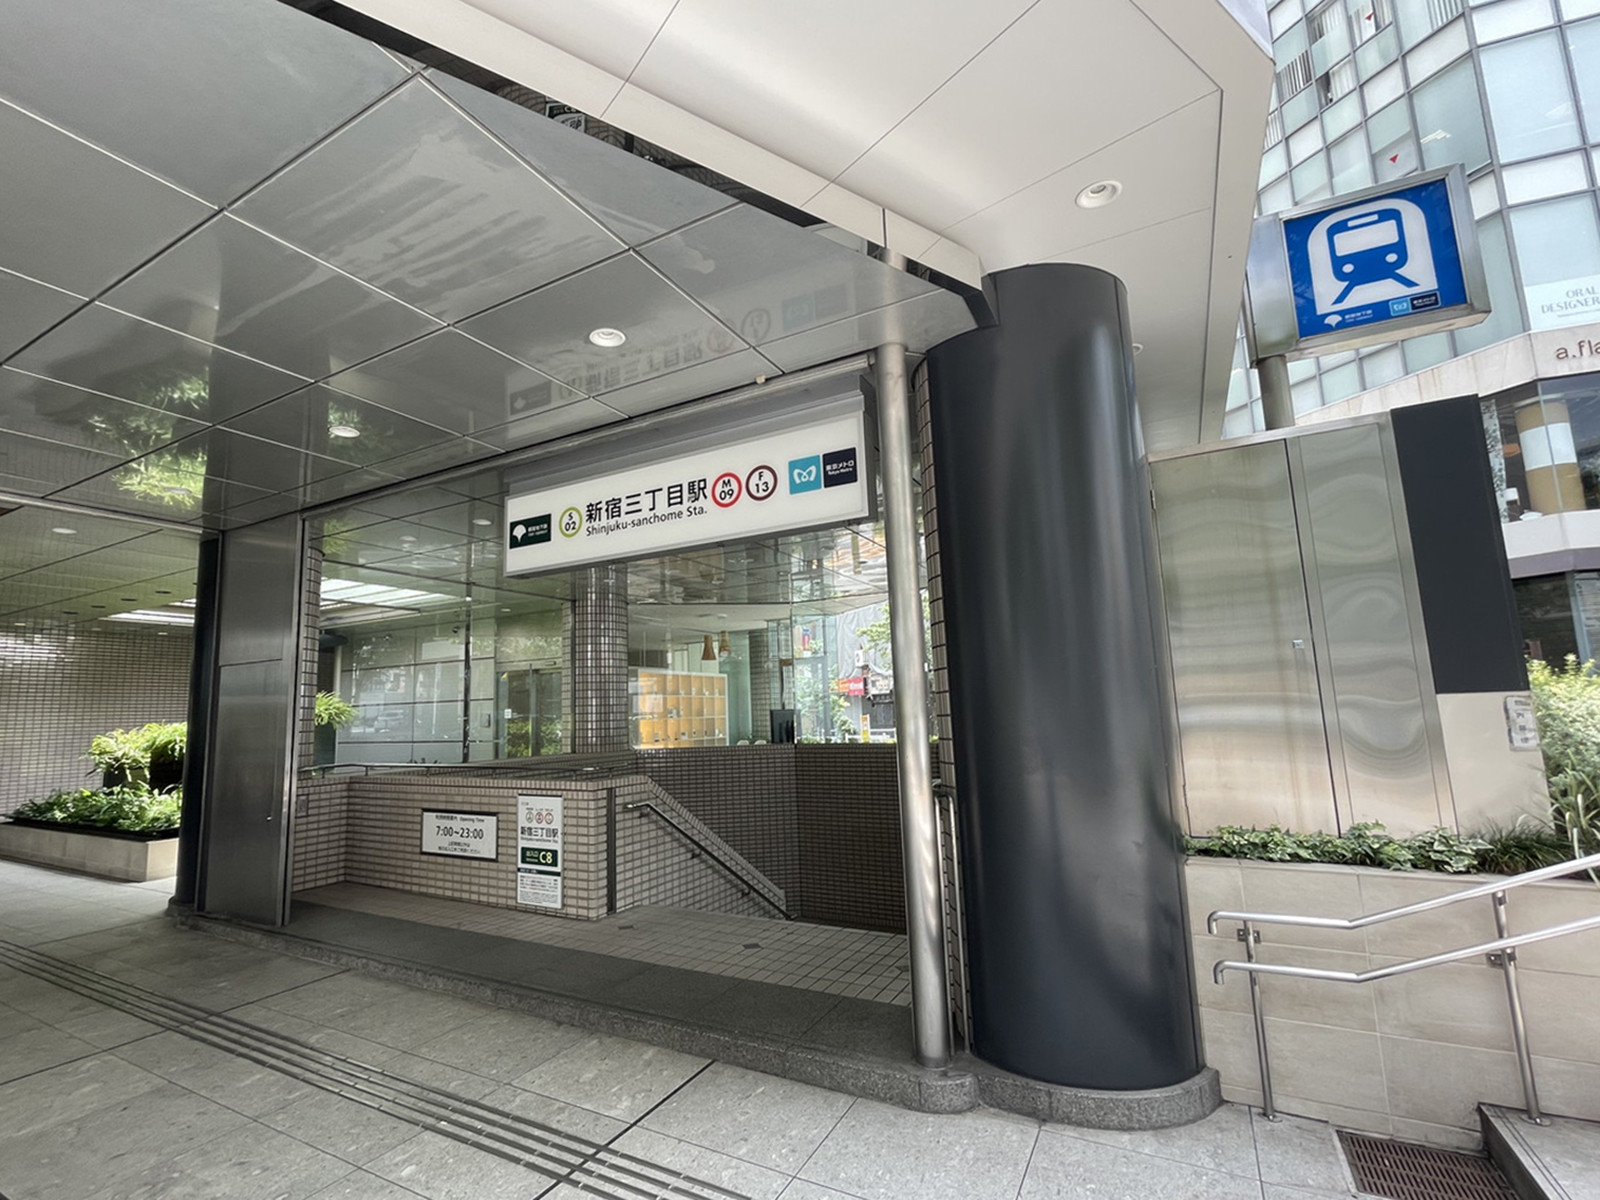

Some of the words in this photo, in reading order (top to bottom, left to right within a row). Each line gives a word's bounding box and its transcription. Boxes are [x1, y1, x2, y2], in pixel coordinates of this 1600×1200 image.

[1566, 286, 1598, 298] ORAL
[758, 471, 764, 481] F
[722, 478, 732, 489] M
[755, 482, 769, 494] 13
[586, 478, 708, 524] 新宿三丁目駅
[719, 489, 734, 501] 09
[568, 512, 573, 521] S
[586, 511, 683, 537] Shinjuku-sanchome
[687, 504, 708, 517] Sta.
[565, 521, 577, 532] 02
[540, 851, 553, 864] C8
